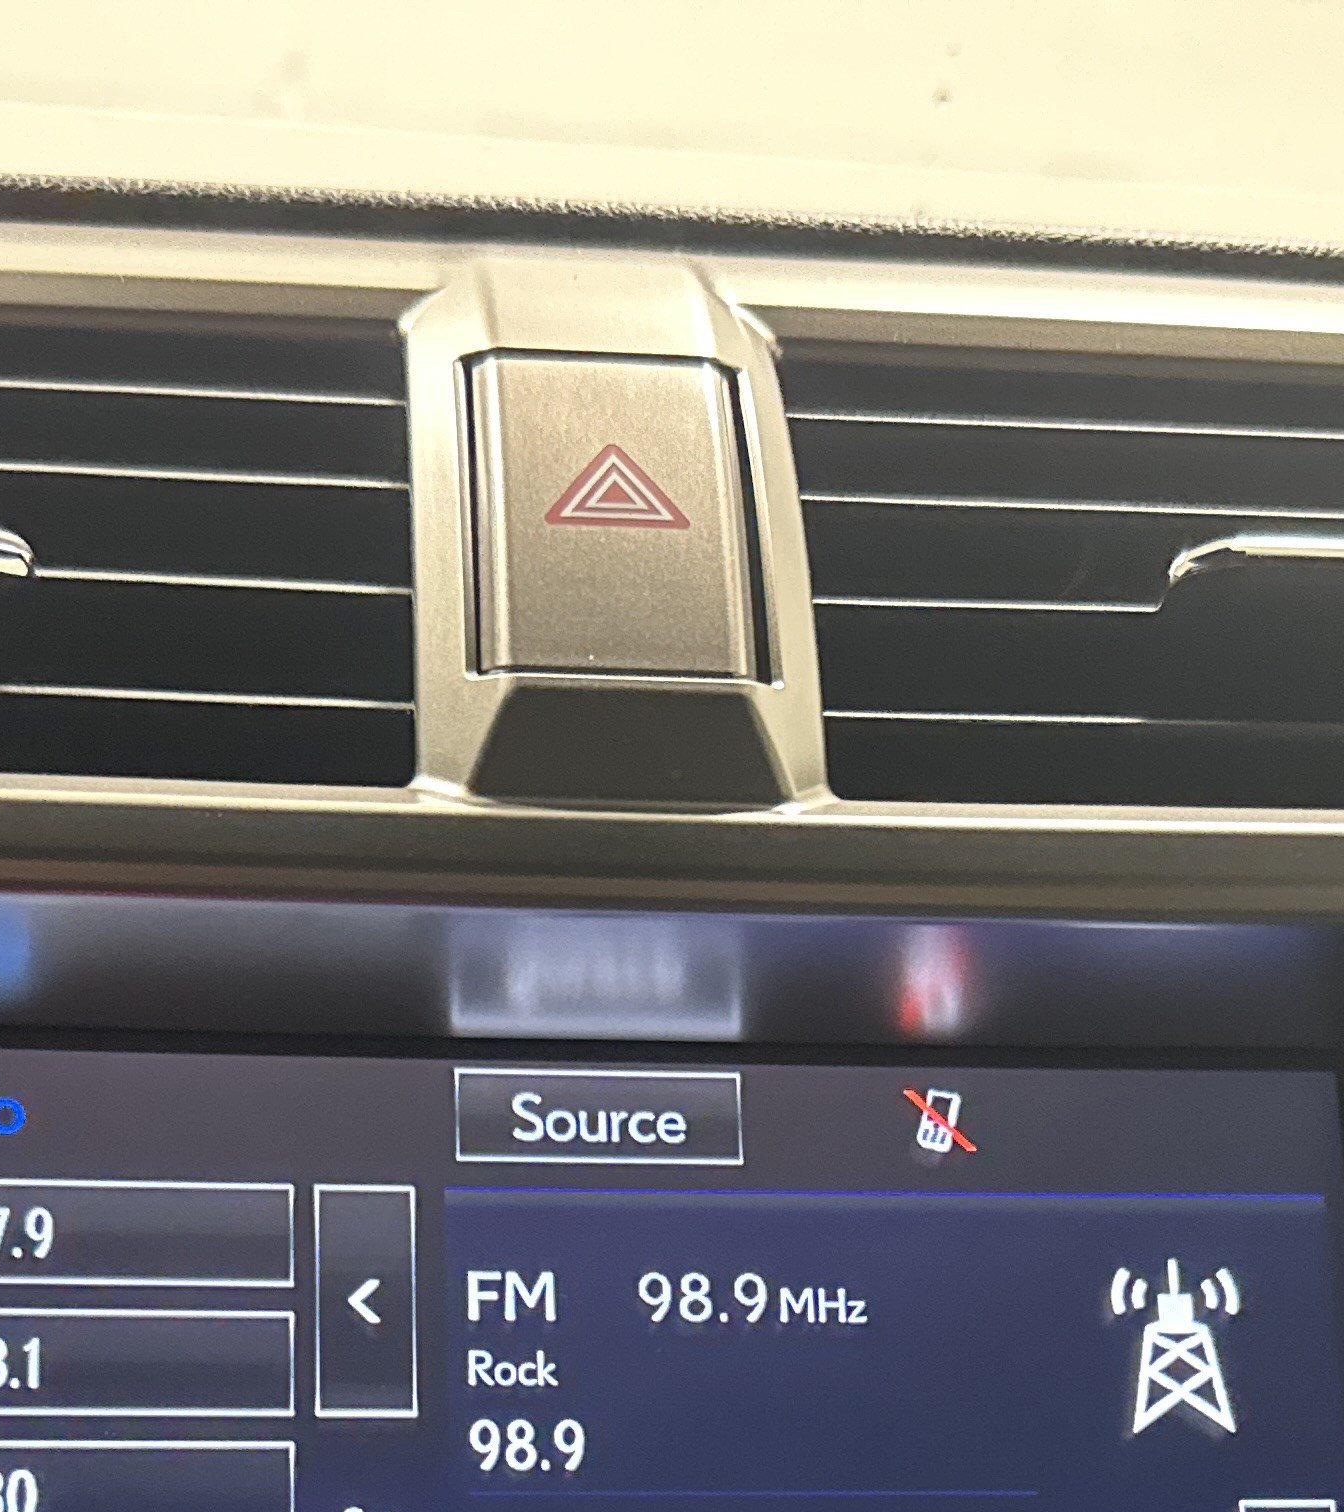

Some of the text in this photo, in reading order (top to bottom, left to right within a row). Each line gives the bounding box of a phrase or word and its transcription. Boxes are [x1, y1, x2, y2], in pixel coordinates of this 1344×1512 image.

[511, 1093, 687, 1145] Source
[466, 1271, 867, 1325] FM 98.9 MHz
[467, 1351, 558, 1387] Rock
[469, 1419, 586, 1472] 98.9
